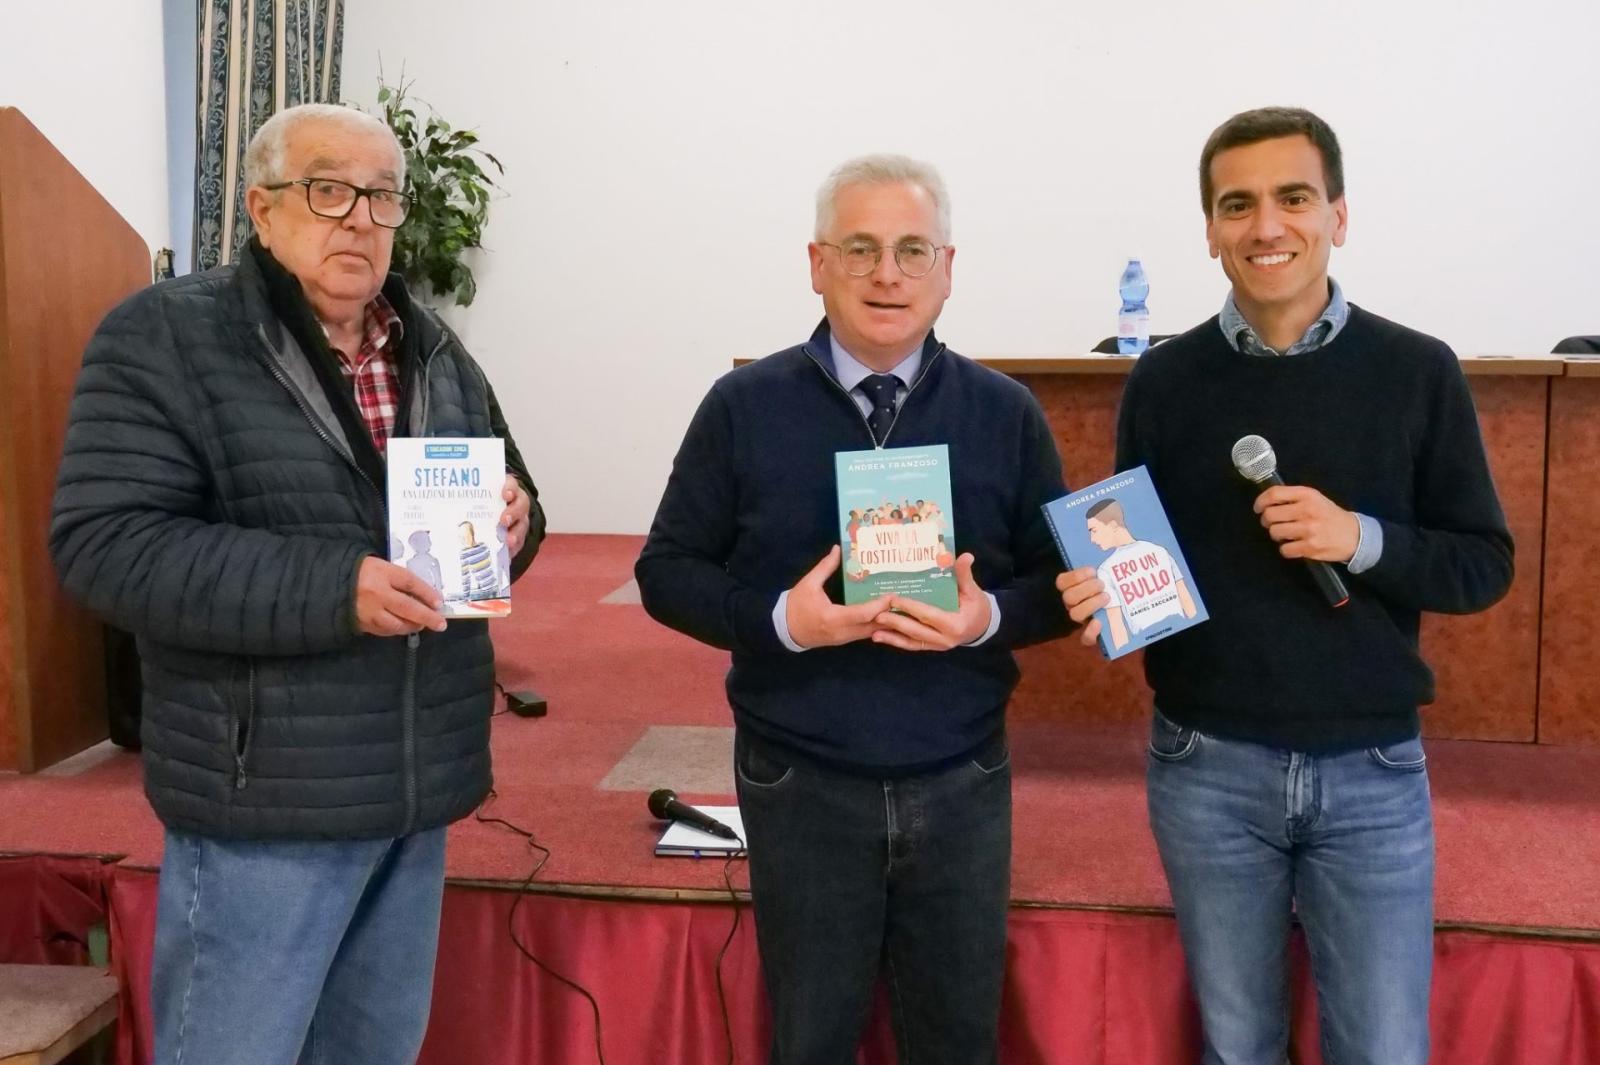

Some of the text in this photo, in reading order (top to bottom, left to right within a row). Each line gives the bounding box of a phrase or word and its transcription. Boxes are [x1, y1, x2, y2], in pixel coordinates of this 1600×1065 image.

[848, 459, 939, 473] ANDREA FRANZOSO
[414, 467, 480, 488] STEFANO
[1065, 477, 1135, 509] ANDREA FRANZOSO
[876, 530, 900, 545] VIVA
[860, 545, 936, 565] COSTITUZIONE
[1111, 552, 1159, 582] ERO UN
[1119, 569, 1171, 605] BULLO
